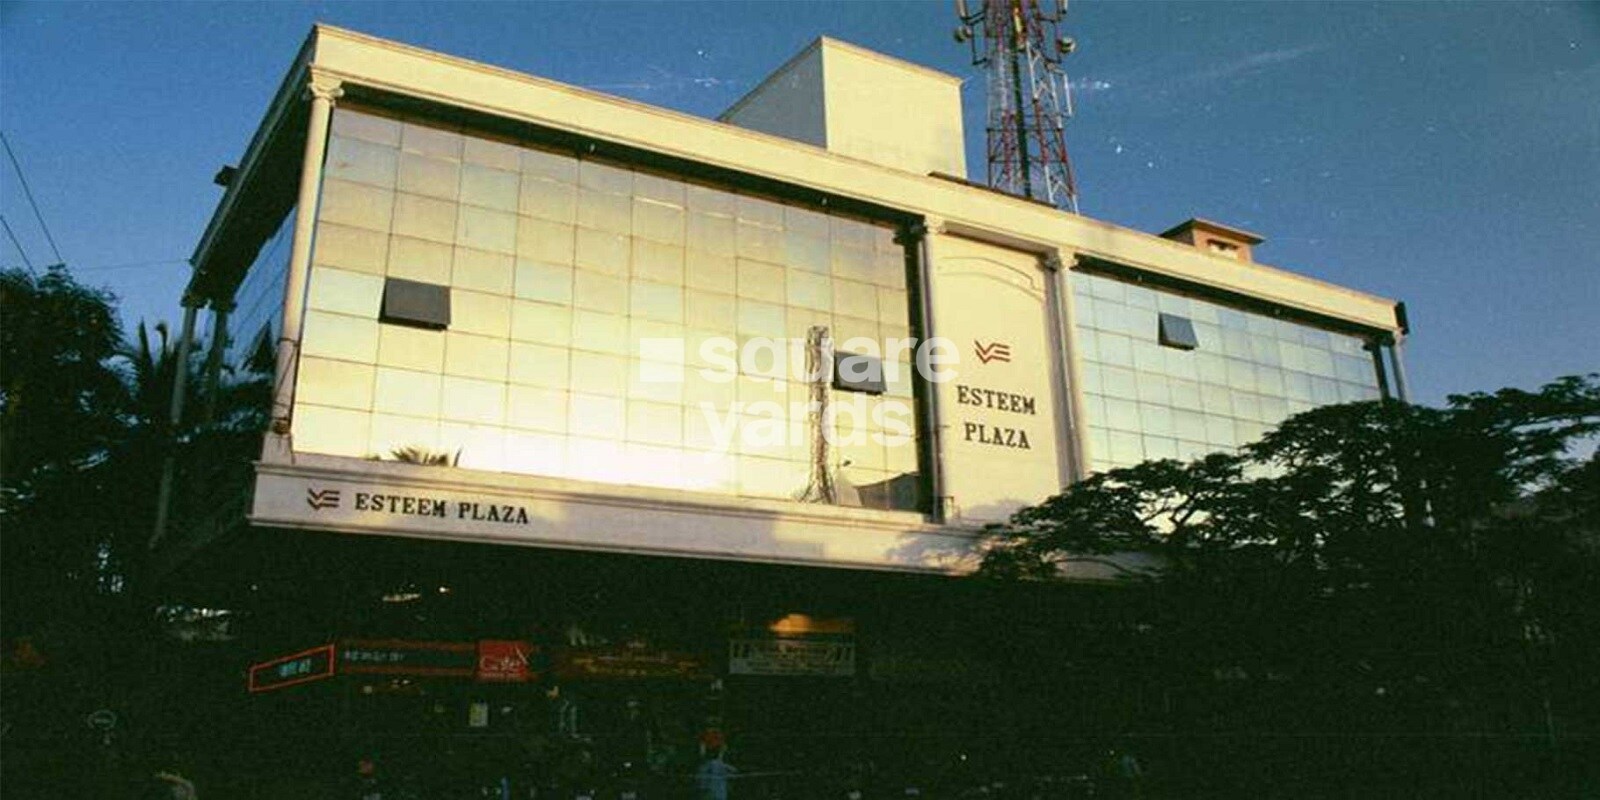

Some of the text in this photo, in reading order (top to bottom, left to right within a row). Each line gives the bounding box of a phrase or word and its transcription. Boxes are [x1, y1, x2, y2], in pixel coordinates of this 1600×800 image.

[957, 385, 1037, 415] ESTEEM
[964, 421, 1031, 449] PLAZA
[354, 492, 446, 518] ESTEEM
[458, 502, 530, 525] PLAZA
